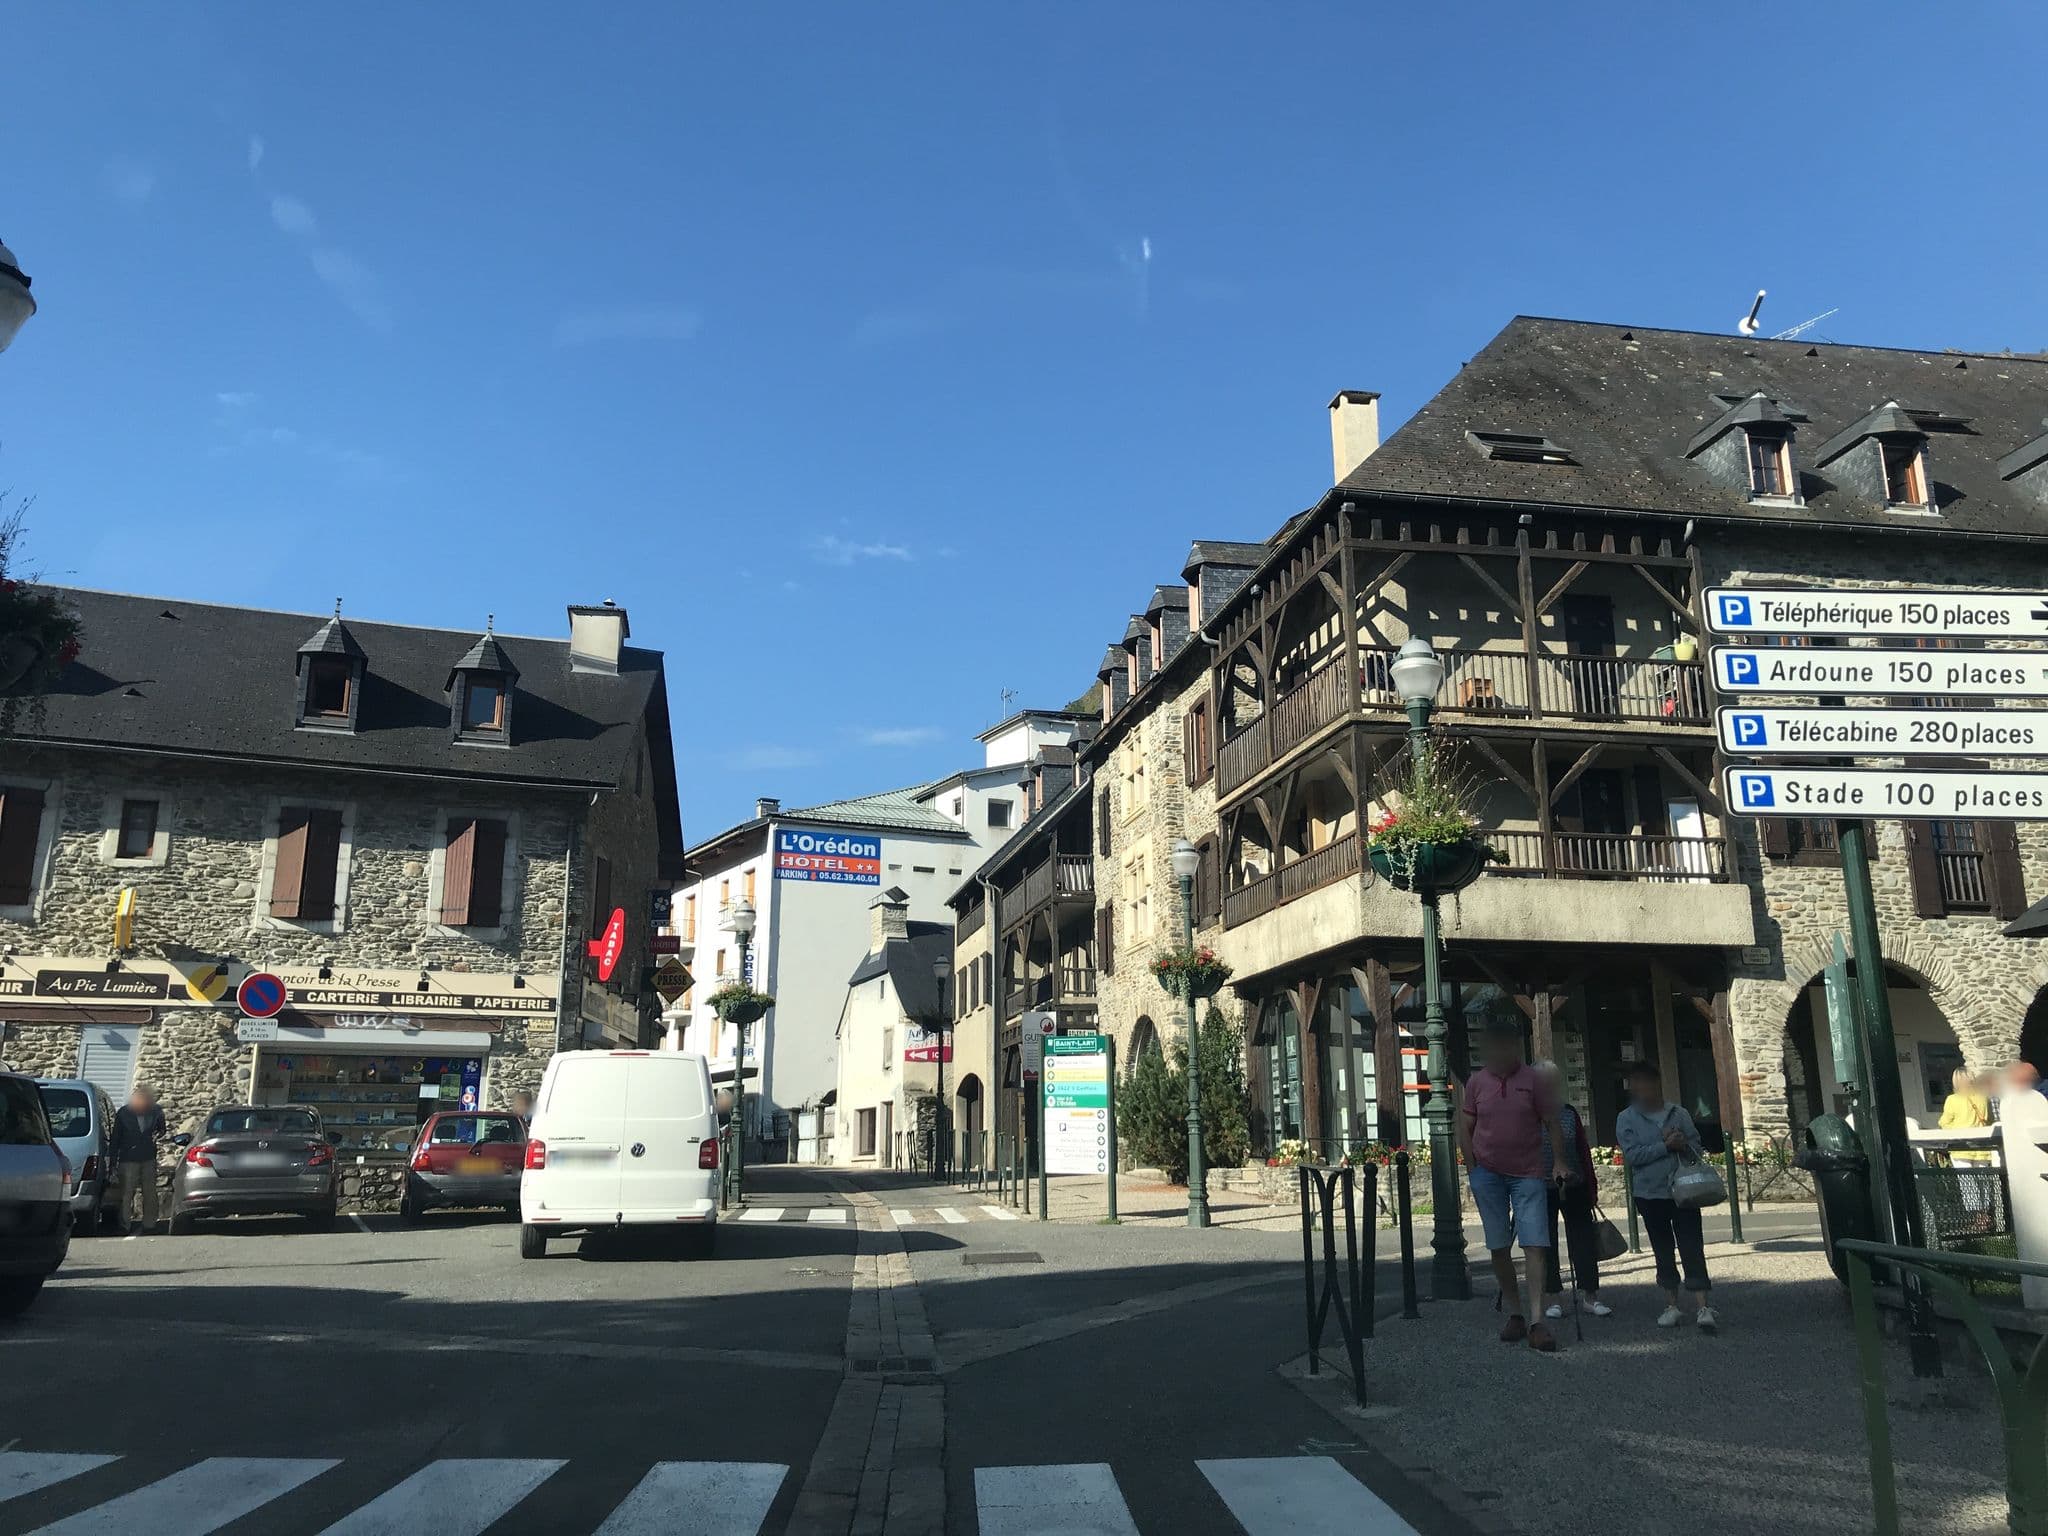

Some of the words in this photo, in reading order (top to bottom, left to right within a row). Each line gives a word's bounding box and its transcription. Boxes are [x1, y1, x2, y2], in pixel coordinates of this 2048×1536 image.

[1760, 600, 1893, 628] Téléphérique
[1899, 603, 1938, 625] 150
[1943, 605, 2011, 629] places
[1770, 660, 1874, 683] Ardoune
[1888, 662, 1933, 683] 150
[1947, 663, 2026, 688] places
[1776, 720, 1898, 743] Télécabine
[1909, 721, 1958, 743] 280
[1961, 723, 2034, 749] places
[1785, 781, 1864, 804] Stade
[1885, 783, 1935, 806] 100
[1955, 785, 2043, 812] places
[780, 834, 876, 857] L'Orédon
[780, 854, 849, 870] HÔTEL
[776, 868, 809, 880] PARKING
[819, 871, 878, 883] 05.62.39.40.04
[604, 922, 620, 966] TABAC
[47, 977, 73, 991] Au
[74, 979, 97, 992] Pic
[103, 979, 158, 994] Lumière
[338, 972, 351, 987] la
[355, 973, 401, 988] Presse
[656, 974, 688, 988] PRESSE
[307, 991, 380, 1004] CARTERIE
[391, 994, 463, 1007] LIBRAIRIE
[474, 997, 550, 1010] PAPETERIE
